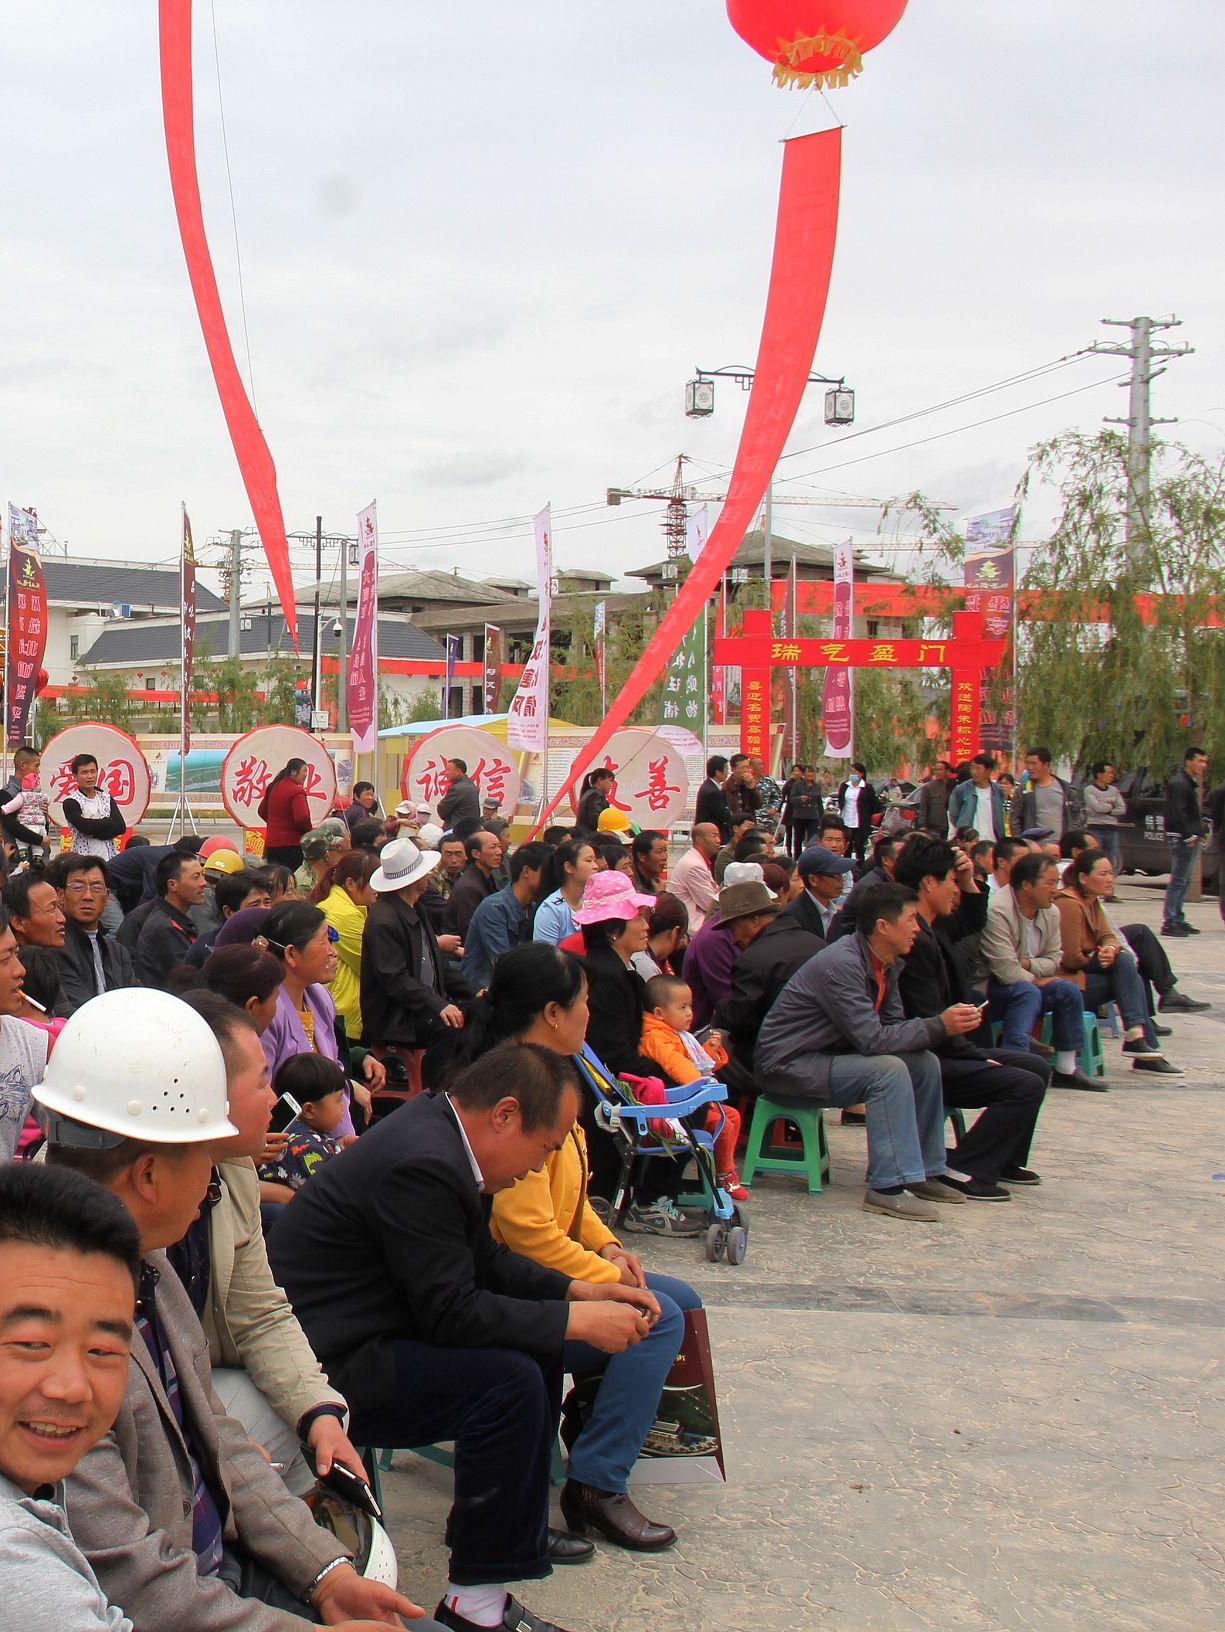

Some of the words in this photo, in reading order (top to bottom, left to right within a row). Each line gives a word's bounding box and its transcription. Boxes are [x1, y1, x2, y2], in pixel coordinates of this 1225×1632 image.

[771, 643, 946, 662] 瑞气盈门
[50, 755, 136, 805] 爱国
[1144, 831, 1165, 841] POLICE
